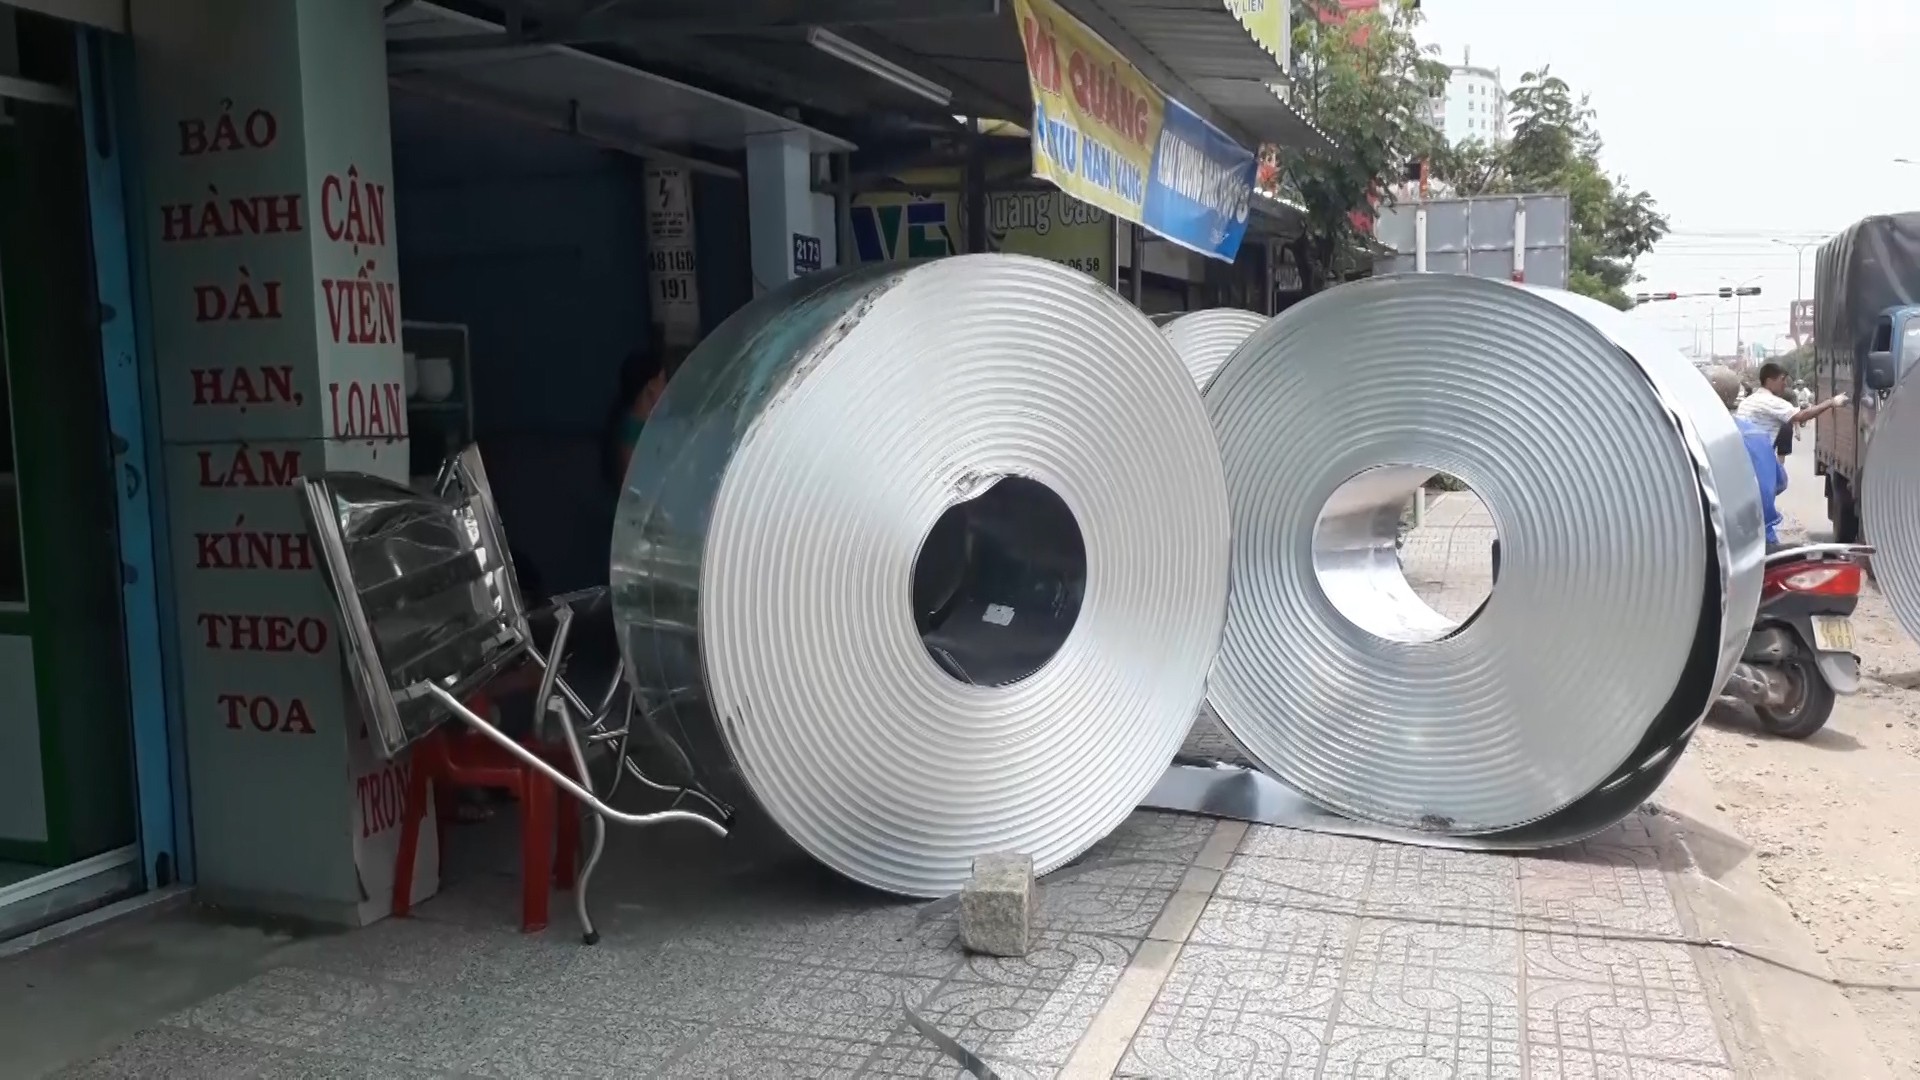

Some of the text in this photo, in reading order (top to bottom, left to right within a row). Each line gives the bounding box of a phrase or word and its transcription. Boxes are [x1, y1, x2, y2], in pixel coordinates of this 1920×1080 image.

[178, 97, 276, 156] BẢO
[1068, 49, 1148, 148] QUẢNG
[1082, 134, 1111, 191] NAM
[161, 183, 303, 242] HÀNH
[321, 163, 385, 255] CẬN
[796, 239, 820, 262] 2173
[1086, 257, 1100, 272] 58
[193, 265, 282, 322] DÀI
[660, 278, 688, 300] 191
[190, 366, 303, 413] HẠN,
[329, 382, 402, 459] LOẠN
[198, 440, 301, 487] LÀM
[194, 514, 313, 569] KÍNH
[197, 613, 328, 654] THEO
[218, 695, 316, 734] TOA
[357, 759, 427, 838] TRÒN
